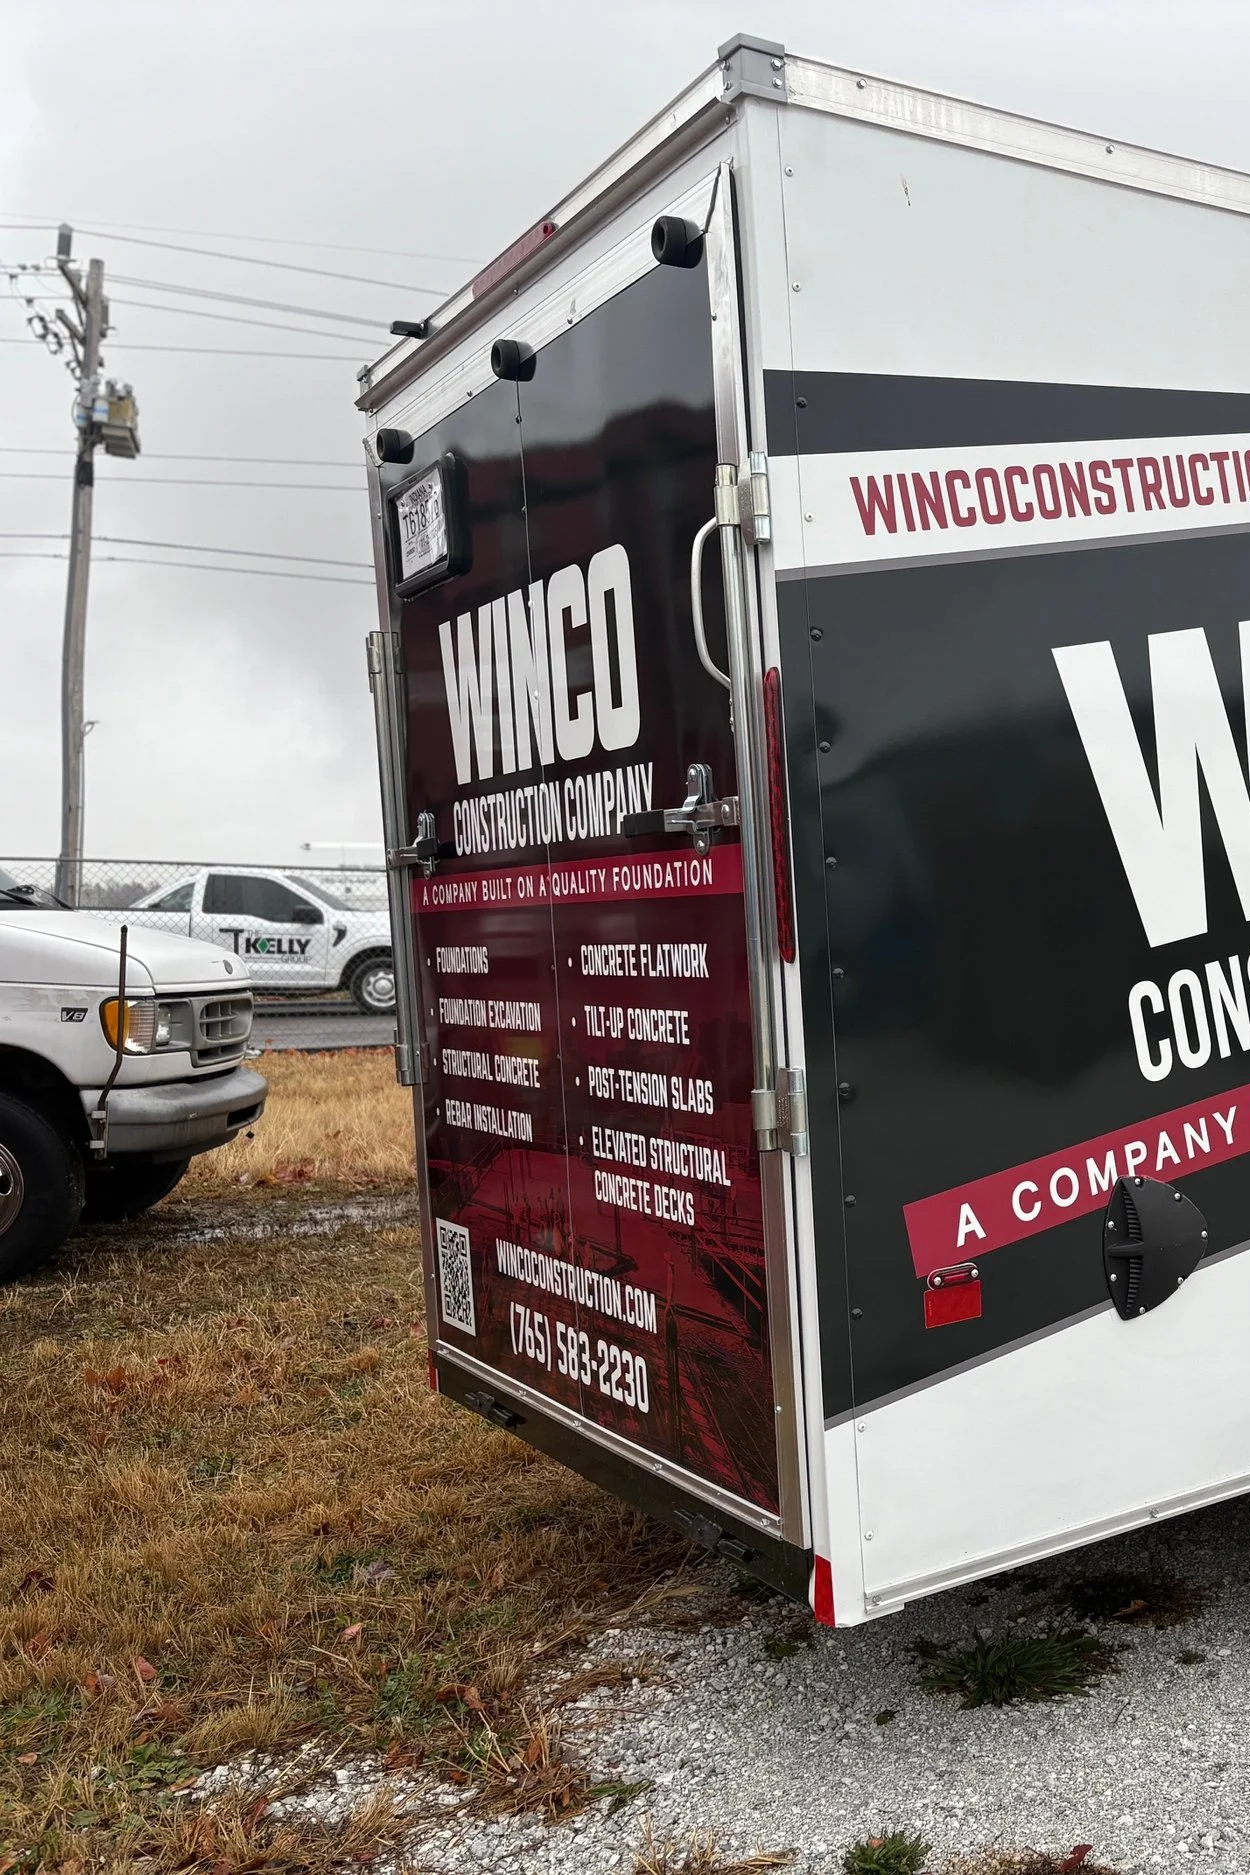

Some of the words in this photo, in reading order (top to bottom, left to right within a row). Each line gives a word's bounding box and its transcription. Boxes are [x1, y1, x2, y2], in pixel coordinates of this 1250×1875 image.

[438, 543, 641, 785] WINCO
[453, 780, 563, 857] CONSTRUCTION
[563, 762, 654, 841] COMPANY
[422, 886, 429, 906] A
[432, 881, 477, 906] COMPANY
[482, 877, 512, 902] BUILT
[517, 876, 534, 899] ON
[539, 874, 547, 897] A
[552, 868, 607, 897] QUALITY
[613, 858, 713, 891] FOUNDATION
[245, 937, 312, 955] KELLY
[436, 946, 489, 974] FOUNDATIONS
[580, 943, 638, 978] CONCRETE
[641, 943, 710, 979] FLATWORK
[62, 1010, 86, 1021] V8
[439, 998, 487, 1027] FOUNDATION
[488, 1001, 542, 1032] EXCAVATION
[584, 1004, 624, 1039] TILT-UP
[628, 1008, 690, 1045] CONCRETE
[442, 1048, 493, 1081] STRUCTURAL
[494, 1054, 541, 1088] CONCRETE
[588, 1065, 668, 1110] POST-TENSION
[671, 1076, 714, 1115] SLABS
[445, 1098, 472, 1130] REBAR
[474, 1103, 533, 1143] INSTALLATION
[592, 1126, 648, 1168] ELEVATED
[650, 1137, 731, 1187] STRUCTURAL
[956, 1203, 987, 1248] A
[1012, 1105, 1238, 1222] COMPANY
[594, 1170, 652, 1215] CONCRETE
[655, 1184, 696, 1226] DECKS
[496, 1238, 658, 1334] WINCOCONSTRUCTION.COM
[510, 1301, 552, 1372] (765)
[556, 1320, 650, 1414] 583-2230
